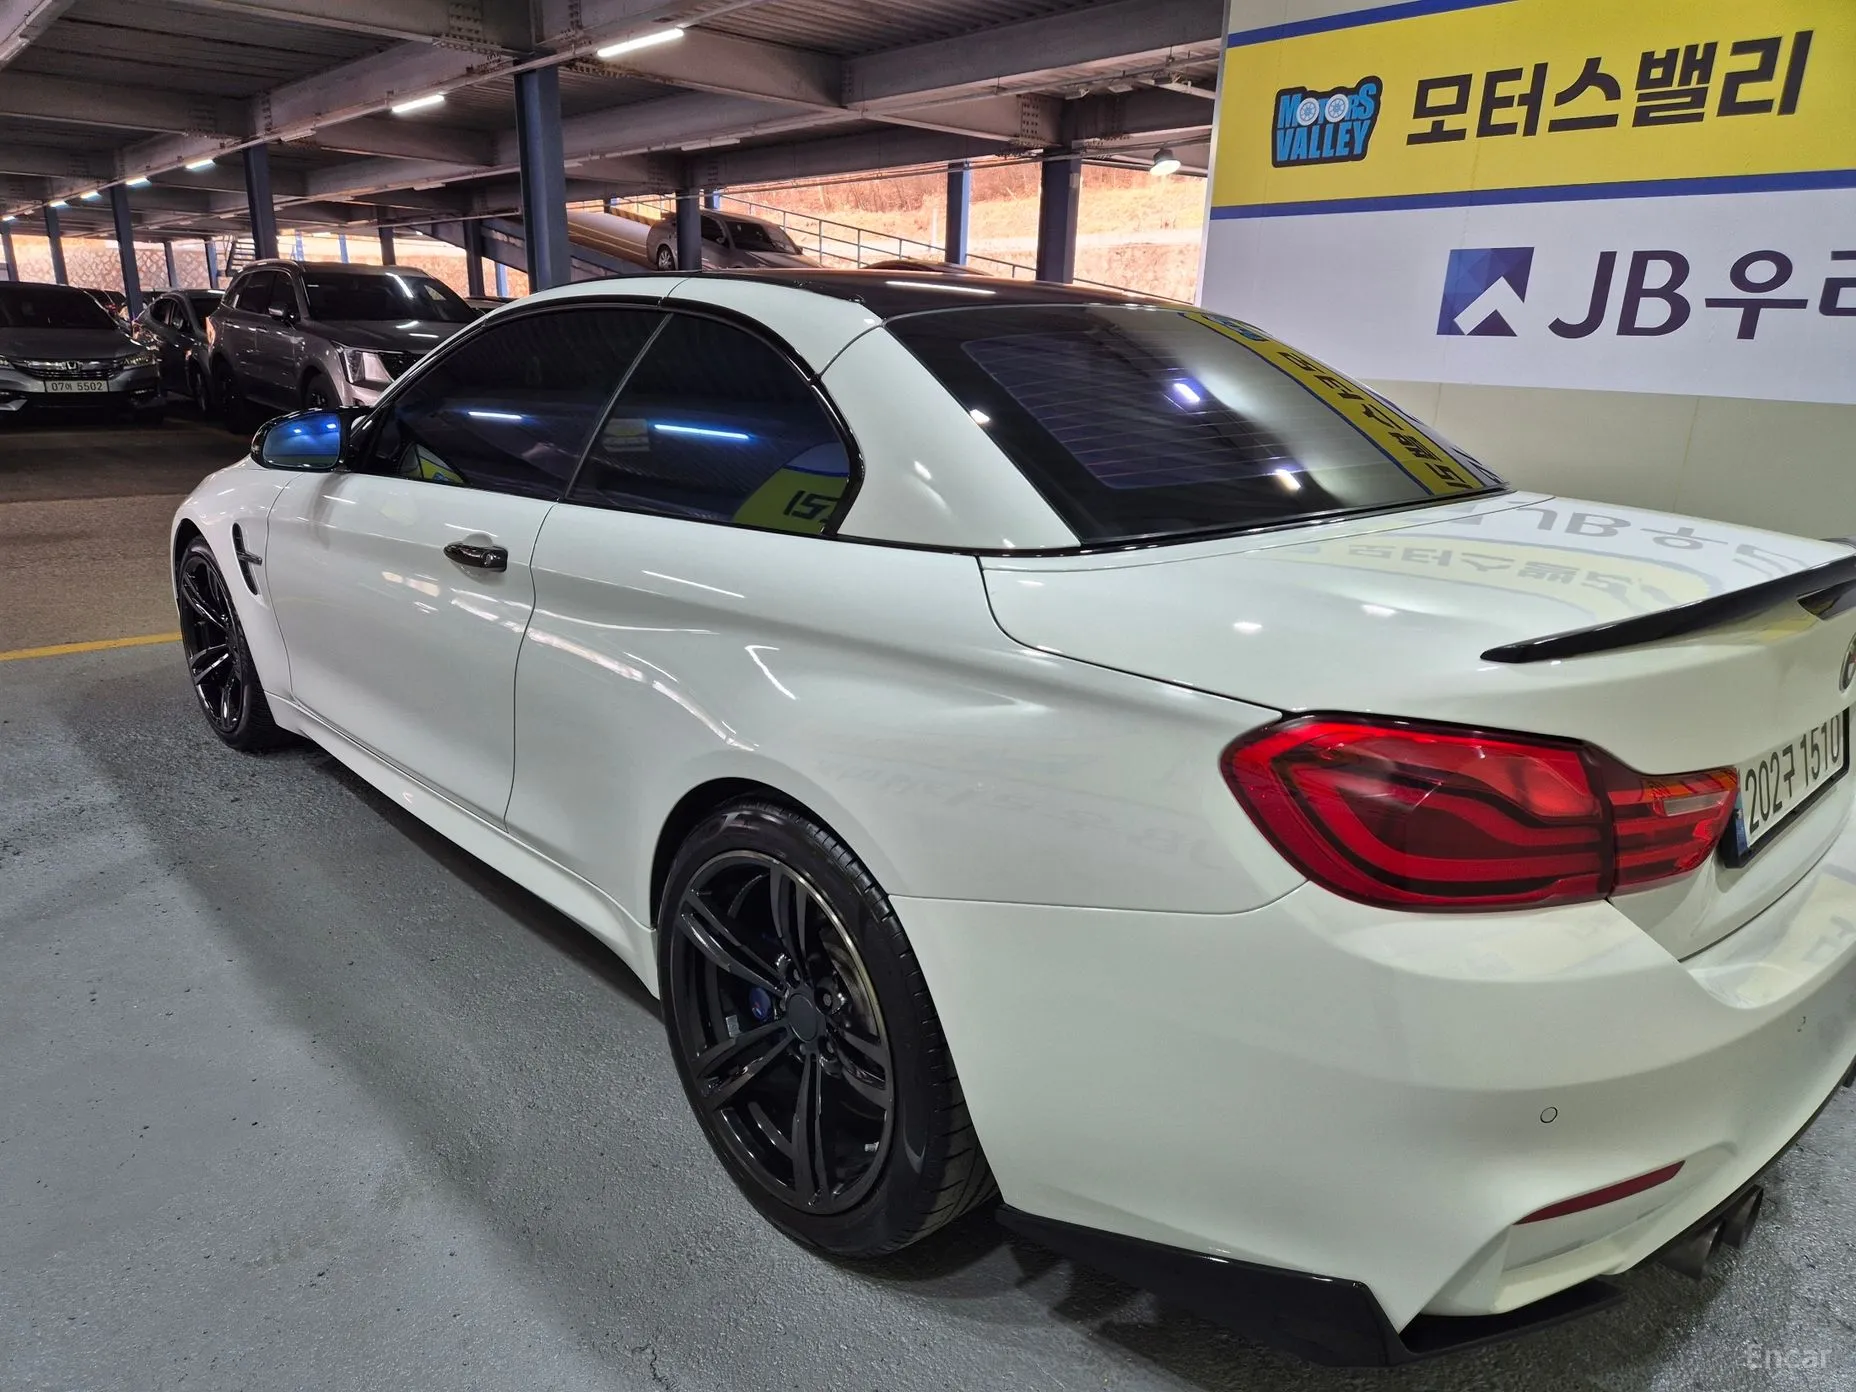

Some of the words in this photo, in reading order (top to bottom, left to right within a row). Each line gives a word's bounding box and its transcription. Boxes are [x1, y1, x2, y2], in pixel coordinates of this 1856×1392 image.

[1277, 83, 1377, 128] MOTORS
[1406, 30, 1813, 147] 모터스밸리
[1276, 120, 1371, 162] VALLEY
[77, 381, 103, 391] 5502
[1744, 743, 1796, 835] 202구
[1800, 714, 1840, 788] 1510
